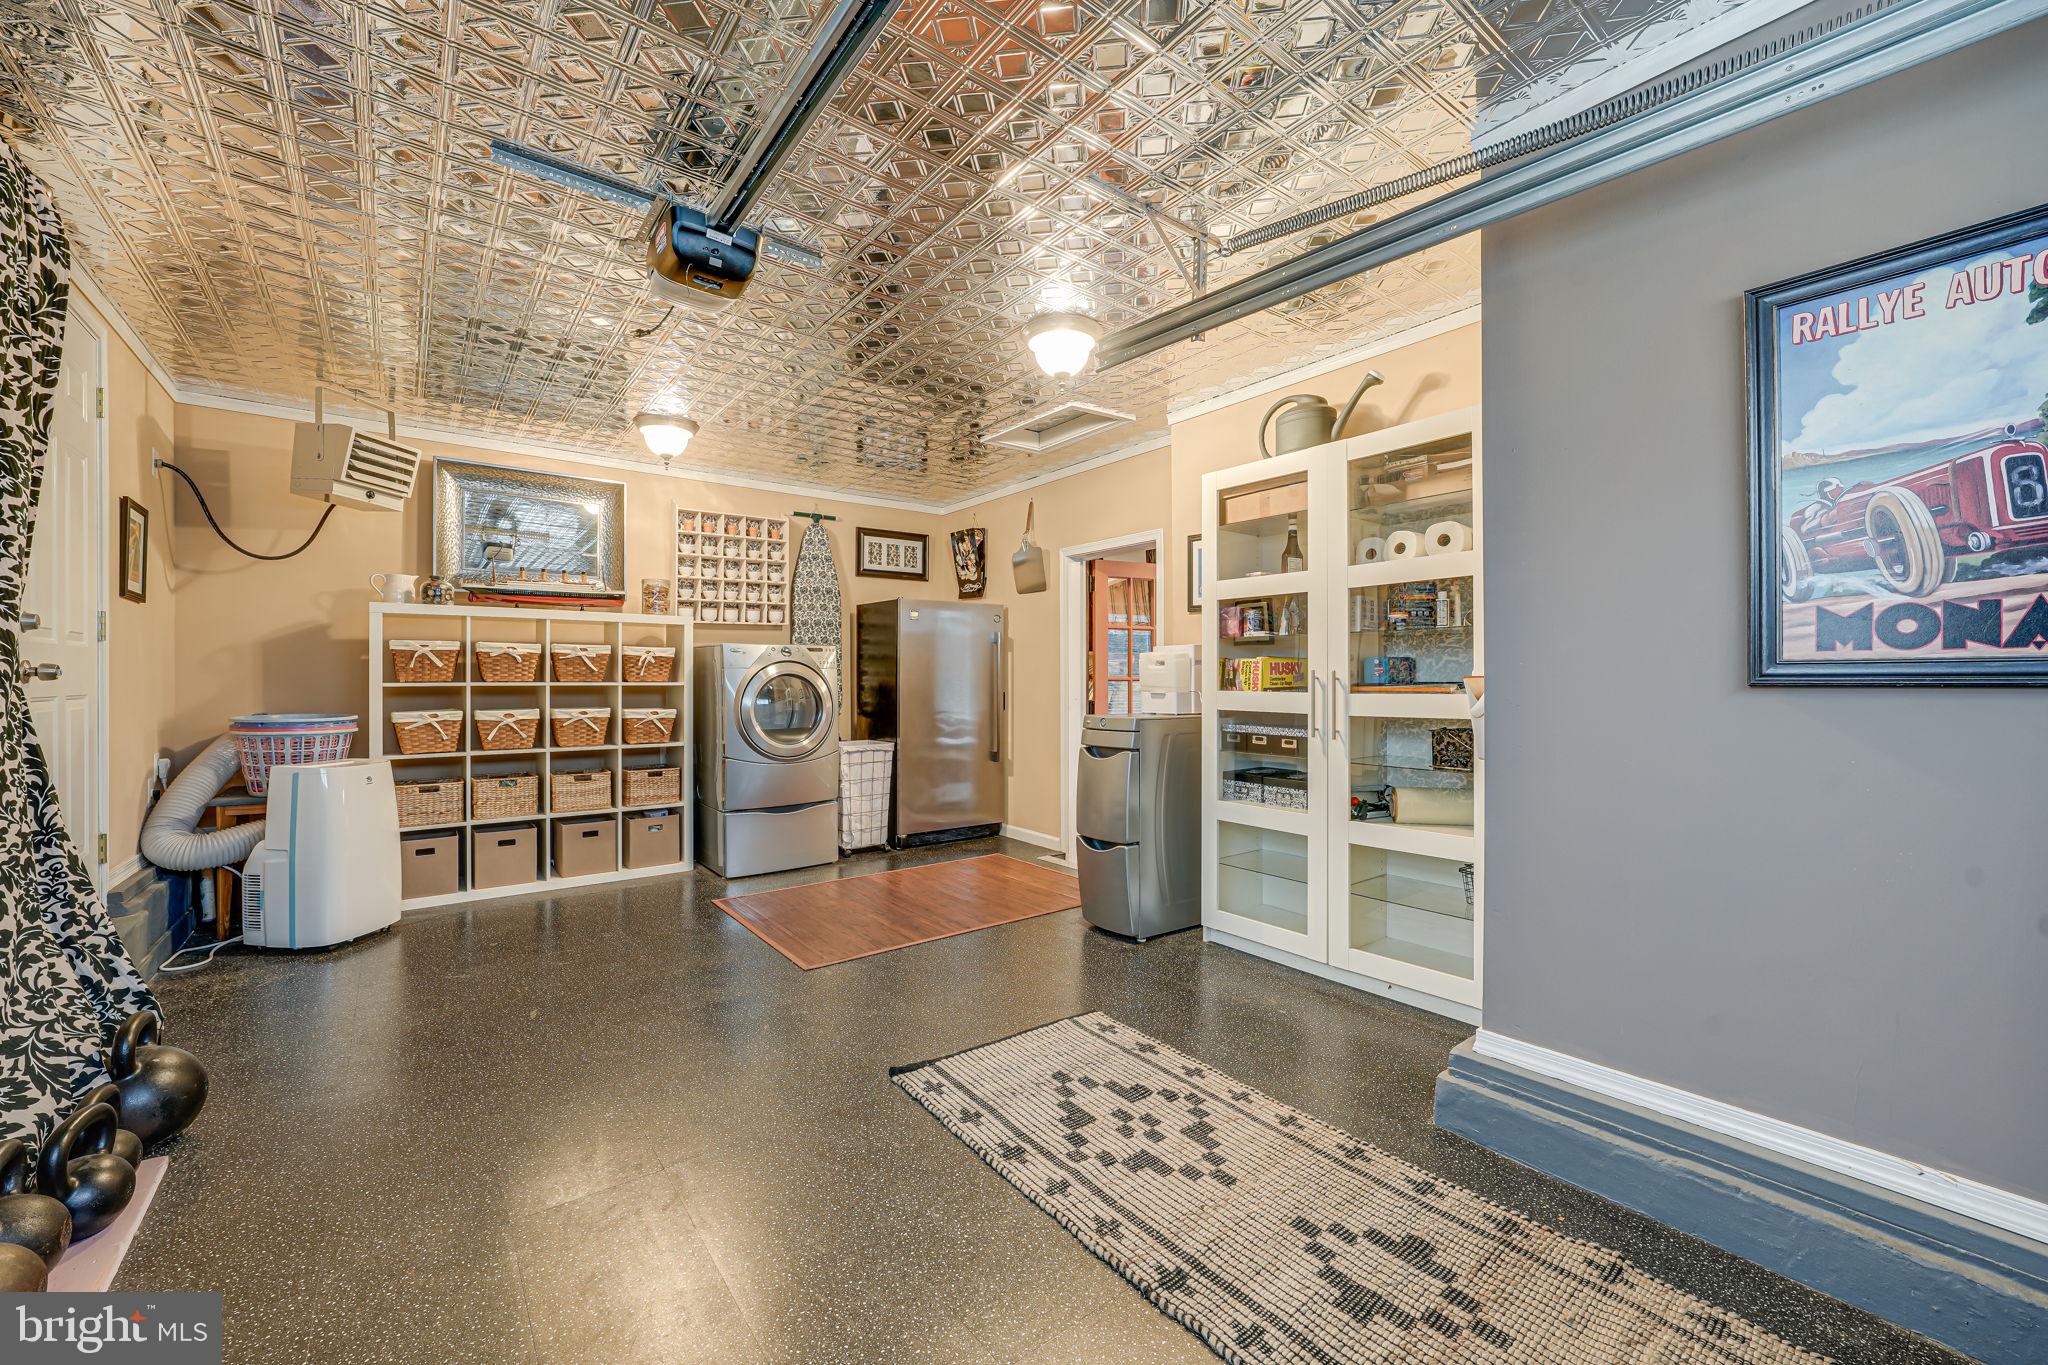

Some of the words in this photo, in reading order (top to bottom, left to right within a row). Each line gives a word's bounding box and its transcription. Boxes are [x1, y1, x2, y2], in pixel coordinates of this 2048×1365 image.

[1791, 282, 1926, 344] RALLYE
[2011, 464, 2045, 505] 8
[1816, 592, 2048, 652] MONA
[1269, 661, 1302, 676] HUSKY
